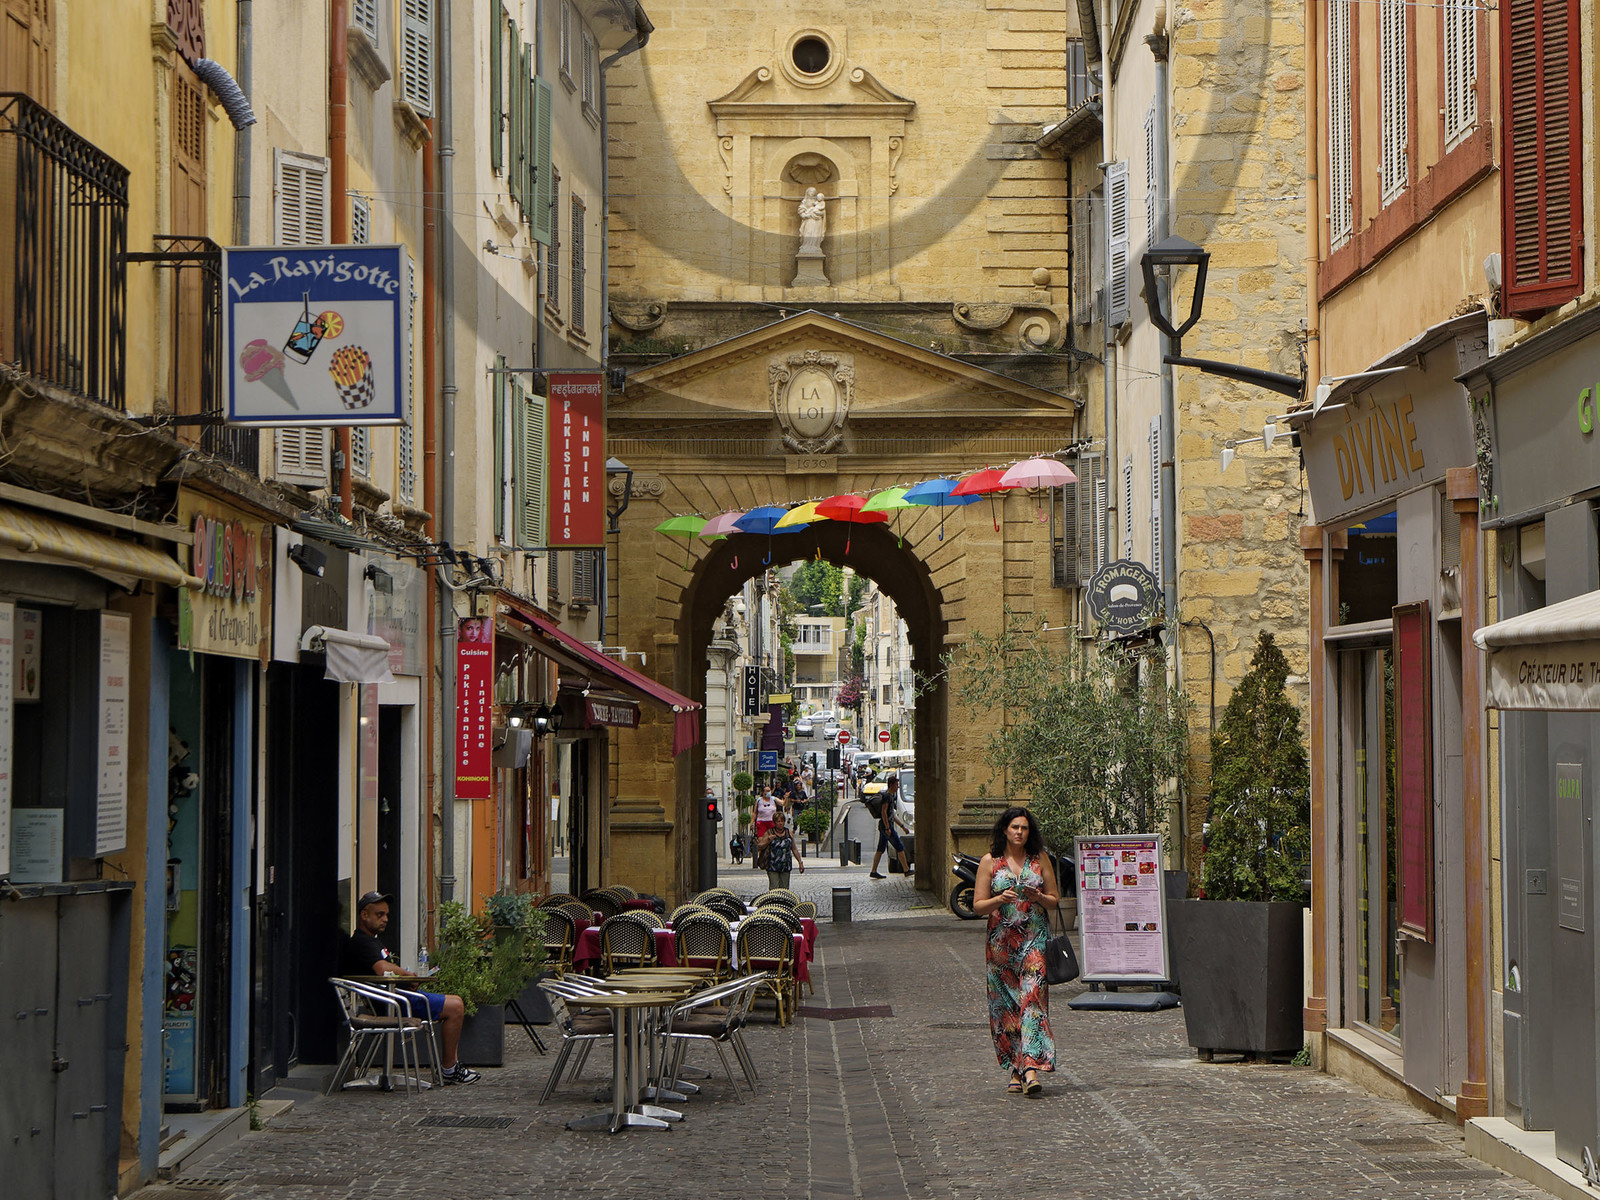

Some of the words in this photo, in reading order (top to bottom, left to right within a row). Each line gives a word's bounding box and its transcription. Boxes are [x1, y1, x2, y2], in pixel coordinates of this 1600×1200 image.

[229, 272, 272, 302] La
[264, 254, 399, 294] Ravigotte
[551, 380, 601, 397] restaurant
[802, 388, 821, 400] LA
[798, 407, 824, 419] LOI
[563, 401, 571, 539] PAKISTANAIS
[582, 415, 590, 503] INDIEN
[797, 460, 827, 469] 1630
[1096, 568, 1153, 594] FROMAGERIE
[1519, 659, 1567, 684] CRÉATEUR
[1570, 662, 1584, 683] DE
[748, 666, 757, 716] HÔTEL
[462, 664, 470, 766] Pakistanaise
[1558, 778, 1580, 799] GUAPA
